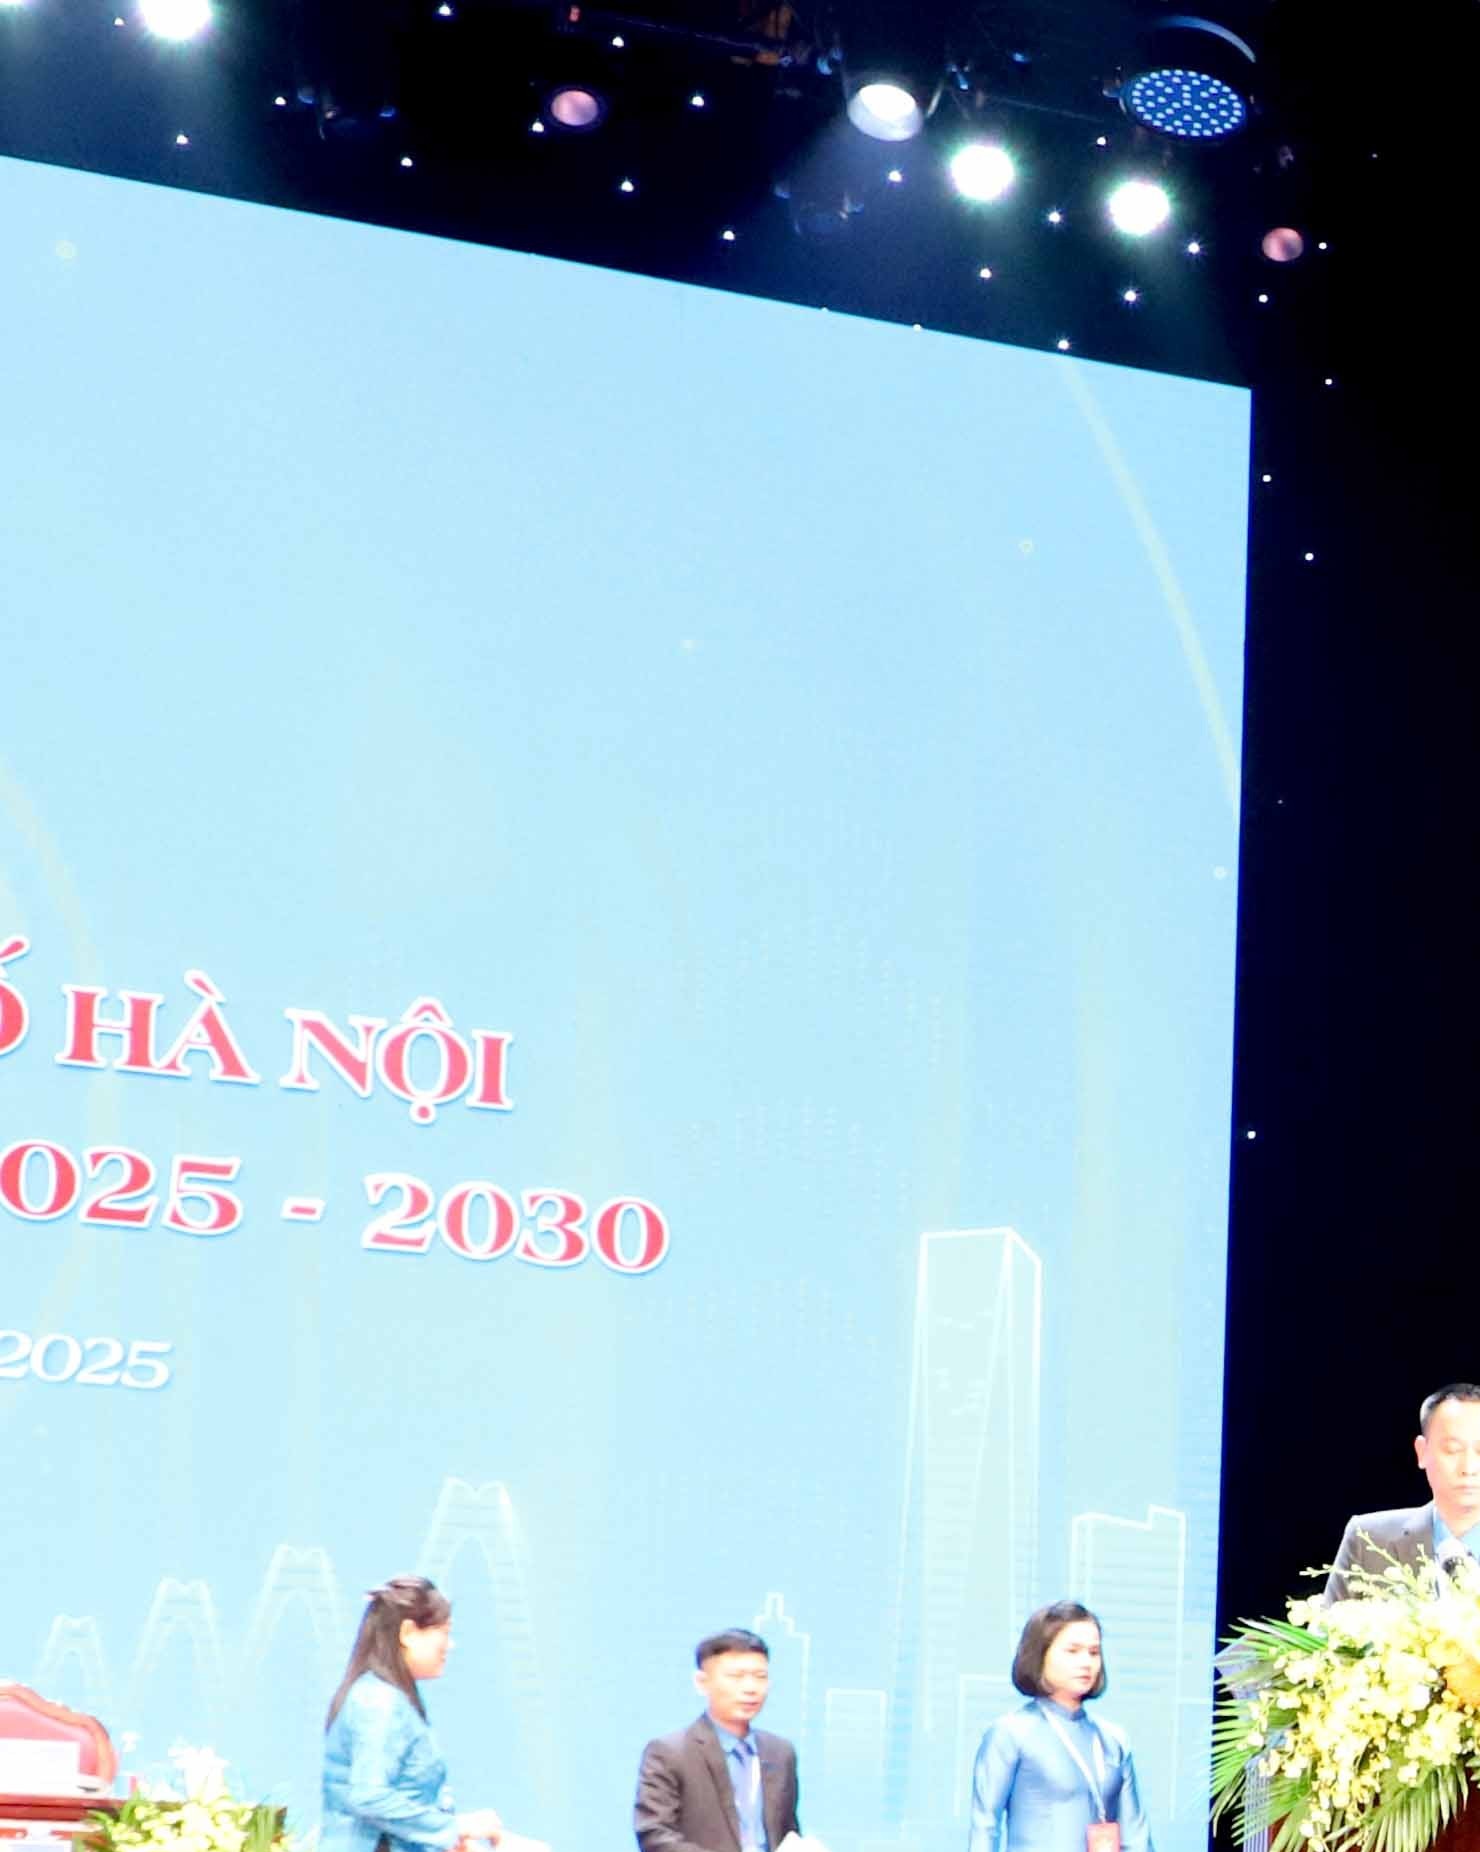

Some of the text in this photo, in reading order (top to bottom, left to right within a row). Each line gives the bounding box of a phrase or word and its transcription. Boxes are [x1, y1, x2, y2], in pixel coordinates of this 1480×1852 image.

[56, 968, 260, 1086] HÀ
[279, 996, 514, 1125] NỘI
[360, 1172, 670, 1275] 2030
[0, 1329, 172, 1389] 2025
